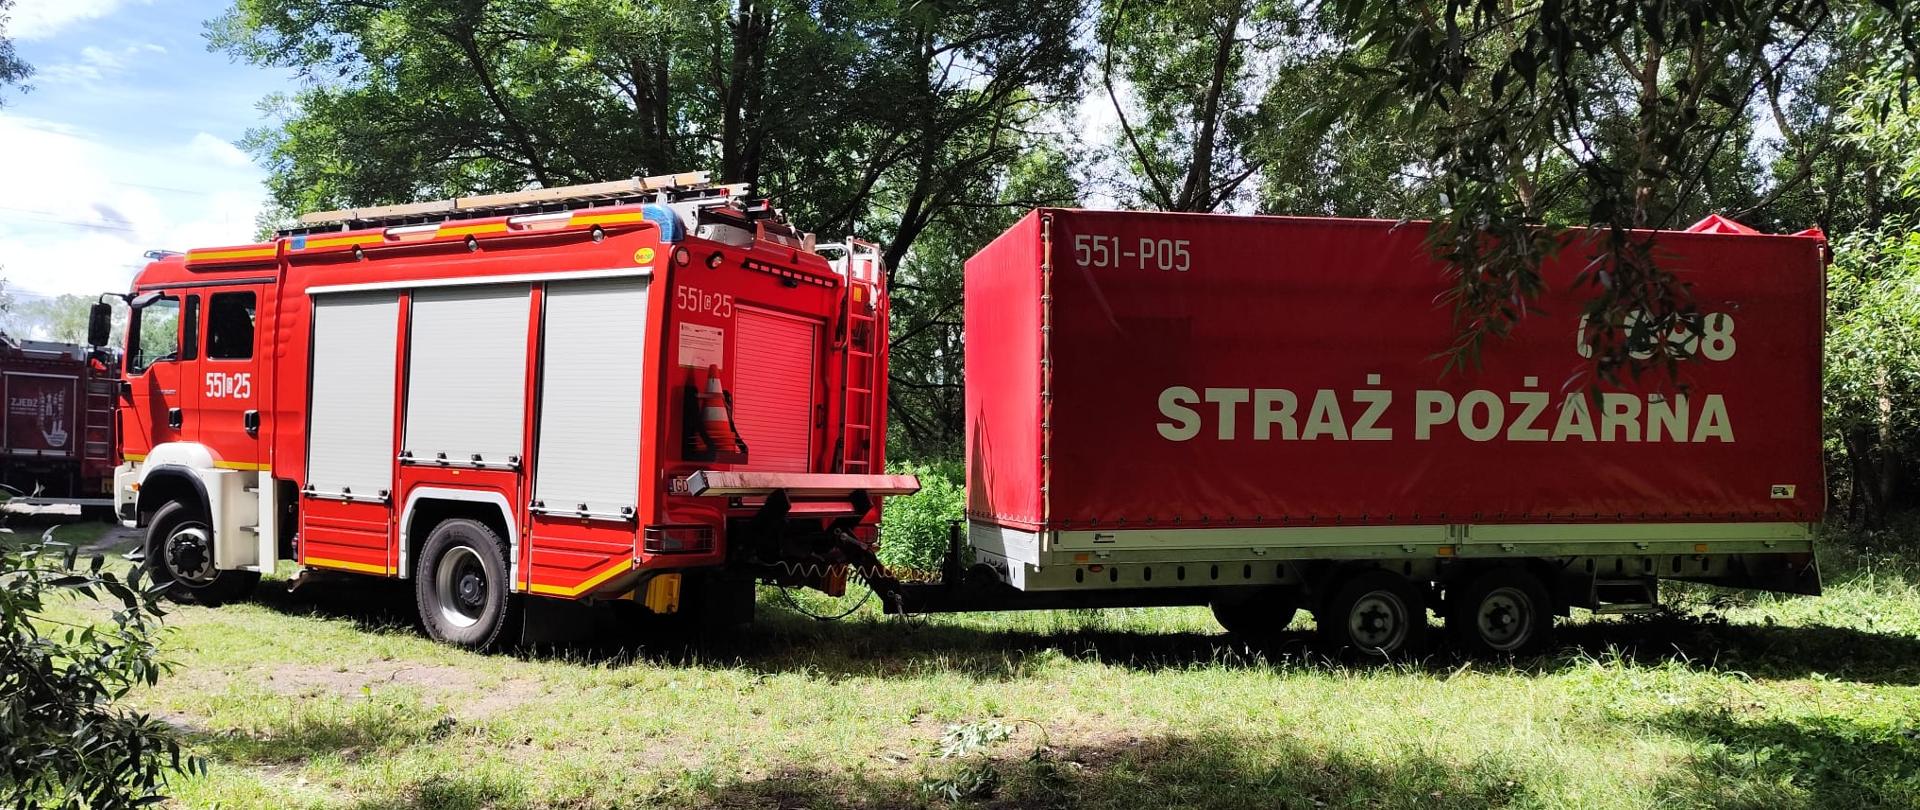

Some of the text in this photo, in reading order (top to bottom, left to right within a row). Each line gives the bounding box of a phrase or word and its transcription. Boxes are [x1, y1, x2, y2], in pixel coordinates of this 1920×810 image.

[1075, 234, 1190, 272] 551-P05
[1156, 373, 1735, 443] STRAŻ POŻARNA
